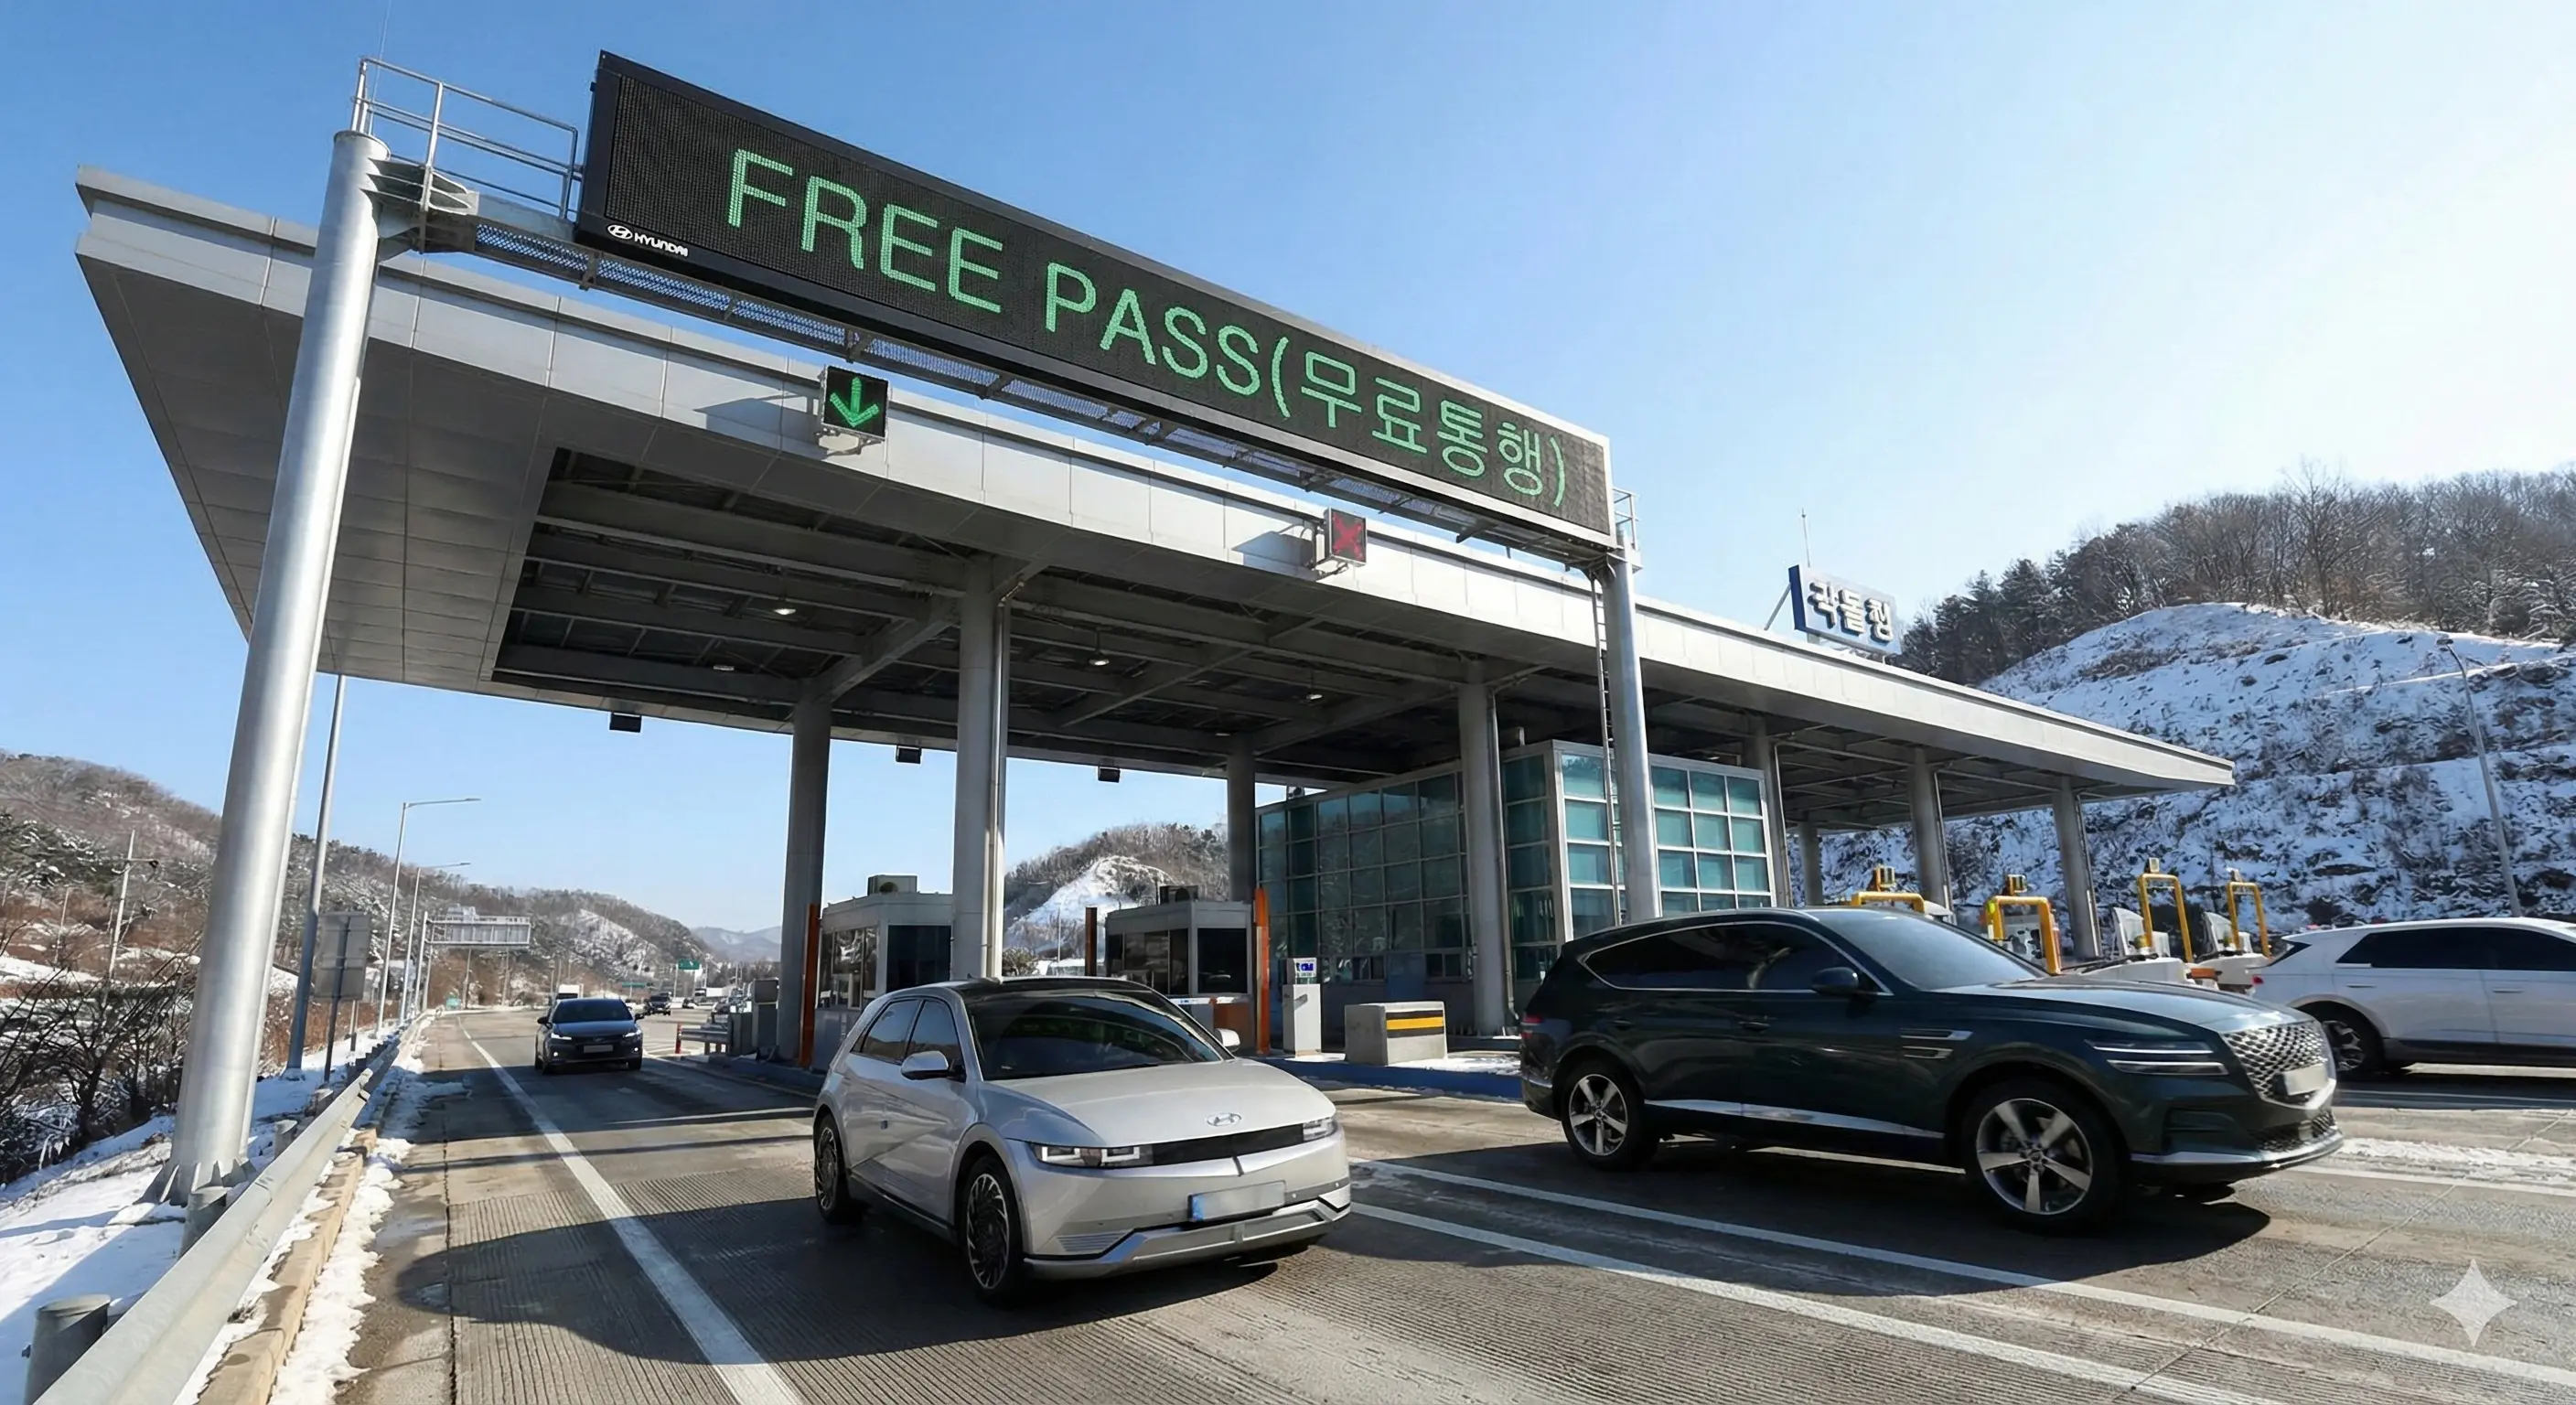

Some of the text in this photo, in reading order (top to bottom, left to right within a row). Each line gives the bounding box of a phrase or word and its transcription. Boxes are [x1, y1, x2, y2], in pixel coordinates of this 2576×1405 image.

[634, 232, 688, 256] HYUNDAI
[728, 149, 1564, 508] FREE PASS(무료통행)
